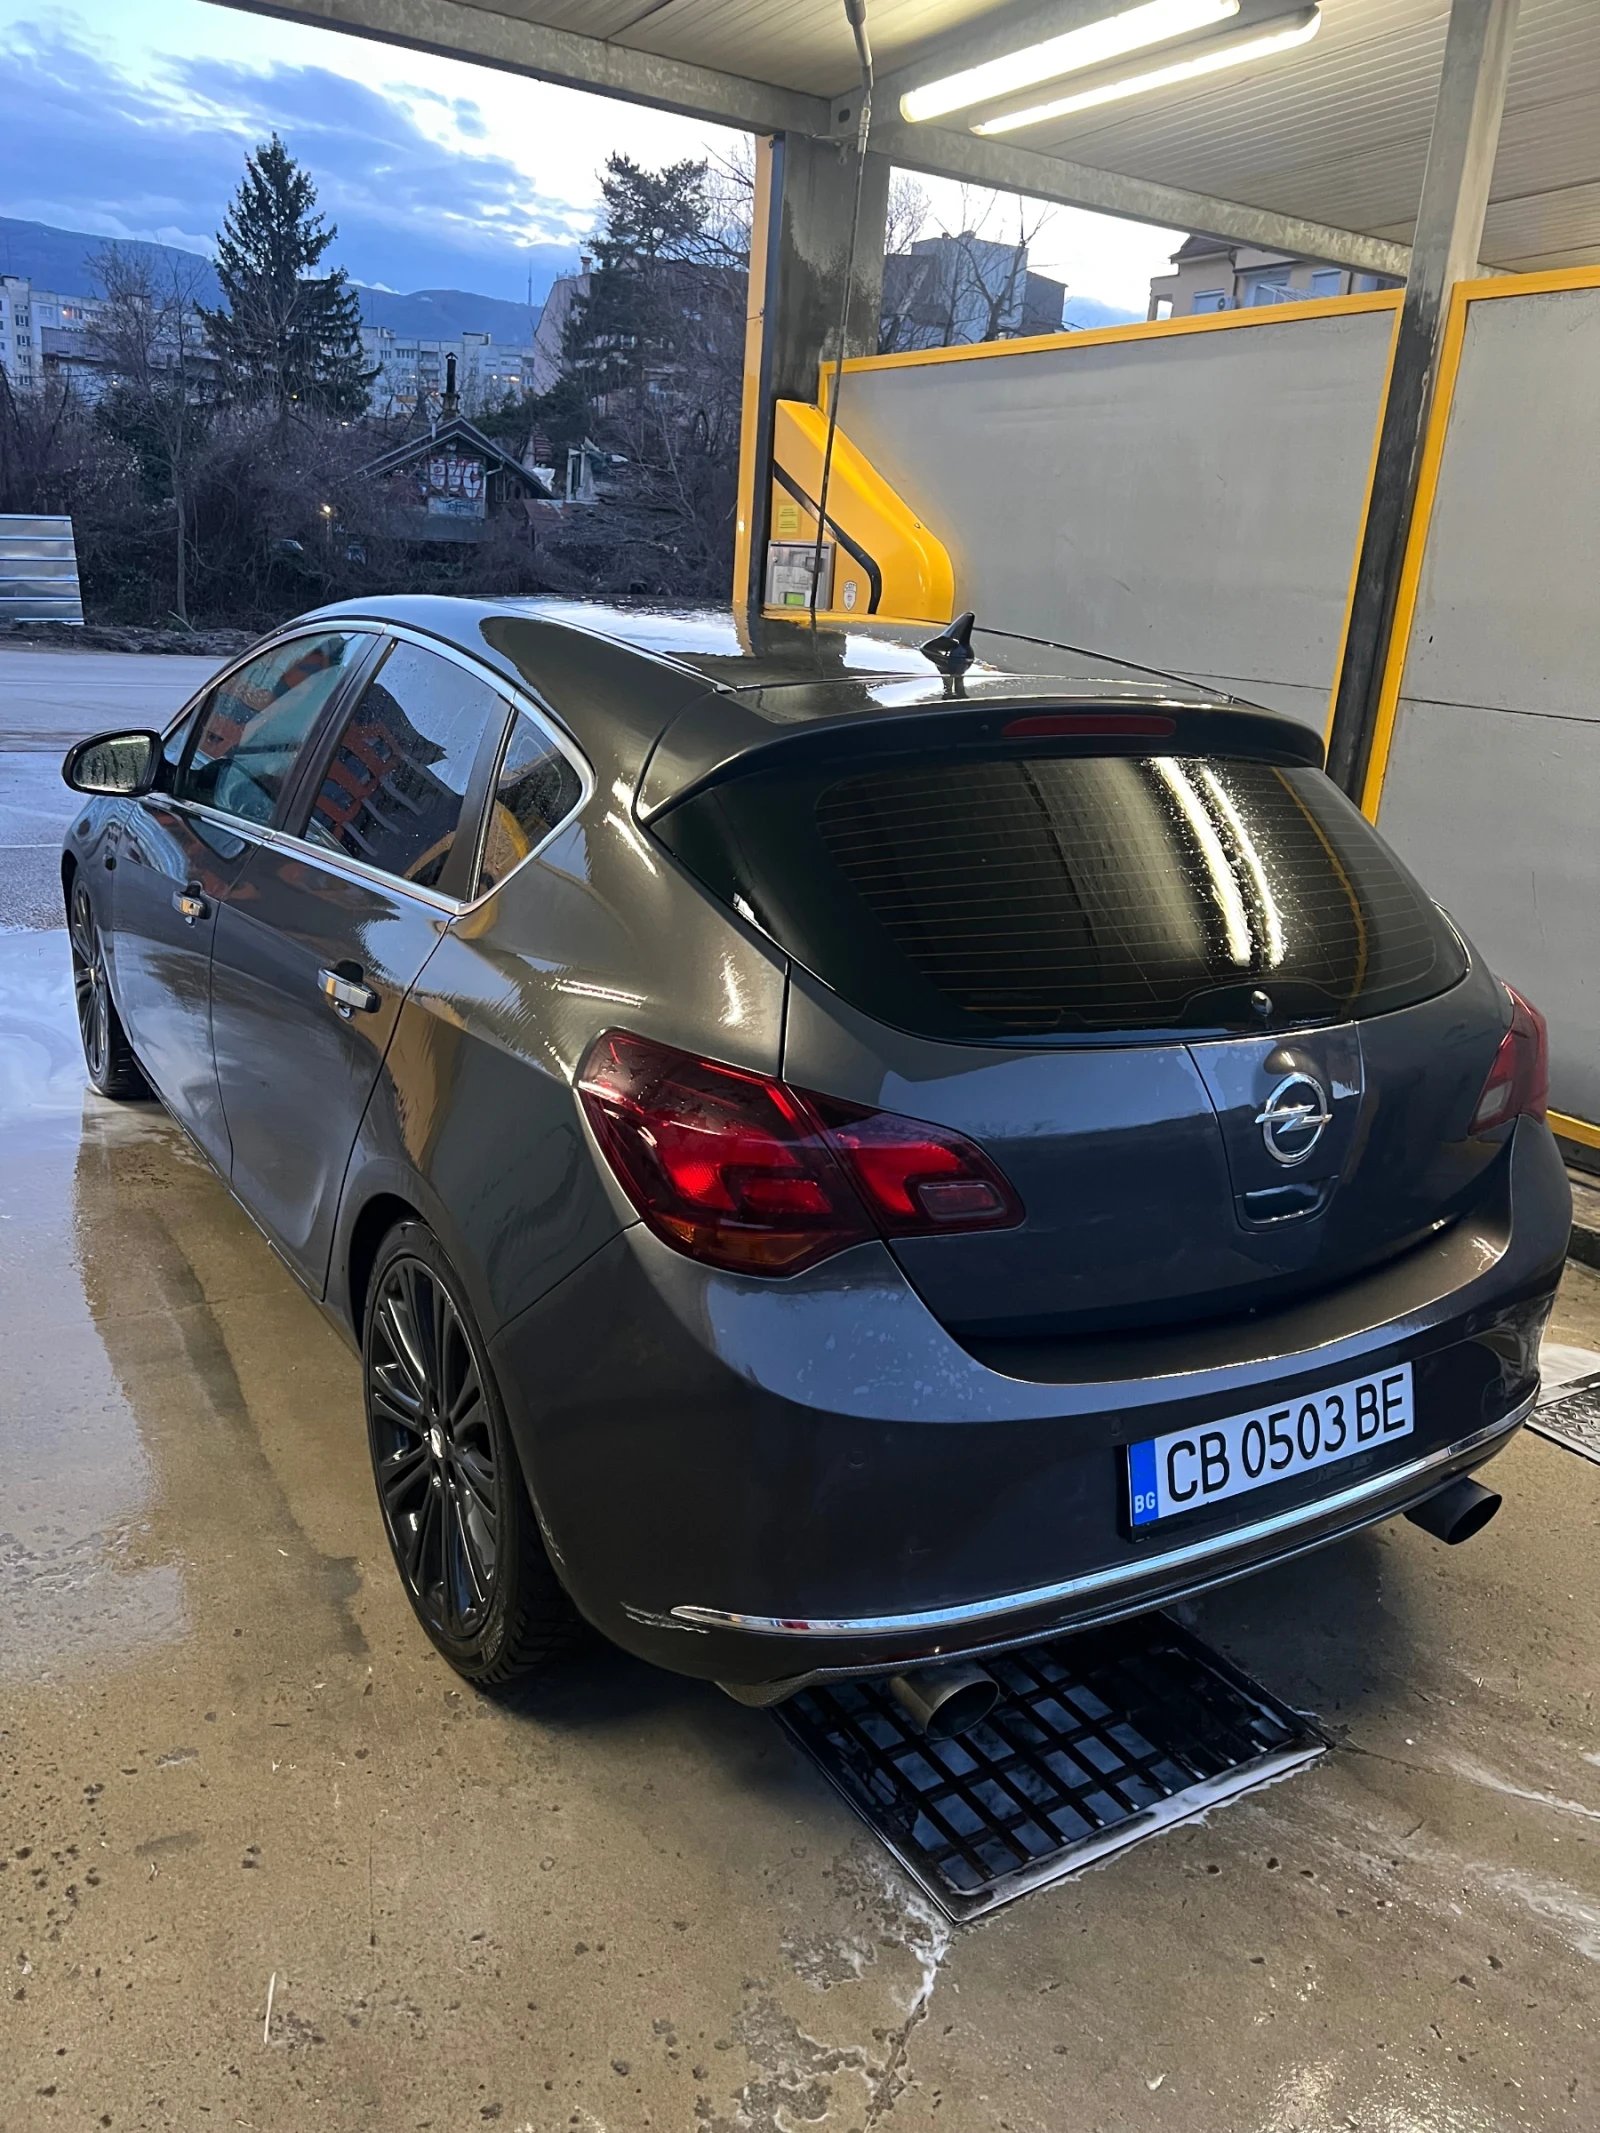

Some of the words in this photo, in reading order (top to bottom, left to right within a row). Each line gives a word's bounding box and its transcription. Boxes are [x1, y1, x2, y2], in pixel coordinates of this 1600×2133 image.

[1166, 1431, 1230, 1502] CB
[1241, 1395, 1347, 1478] 0503
[1355, 1373, 1406, 1443] BE
[1134, 1491, 1156, 1514] BG
